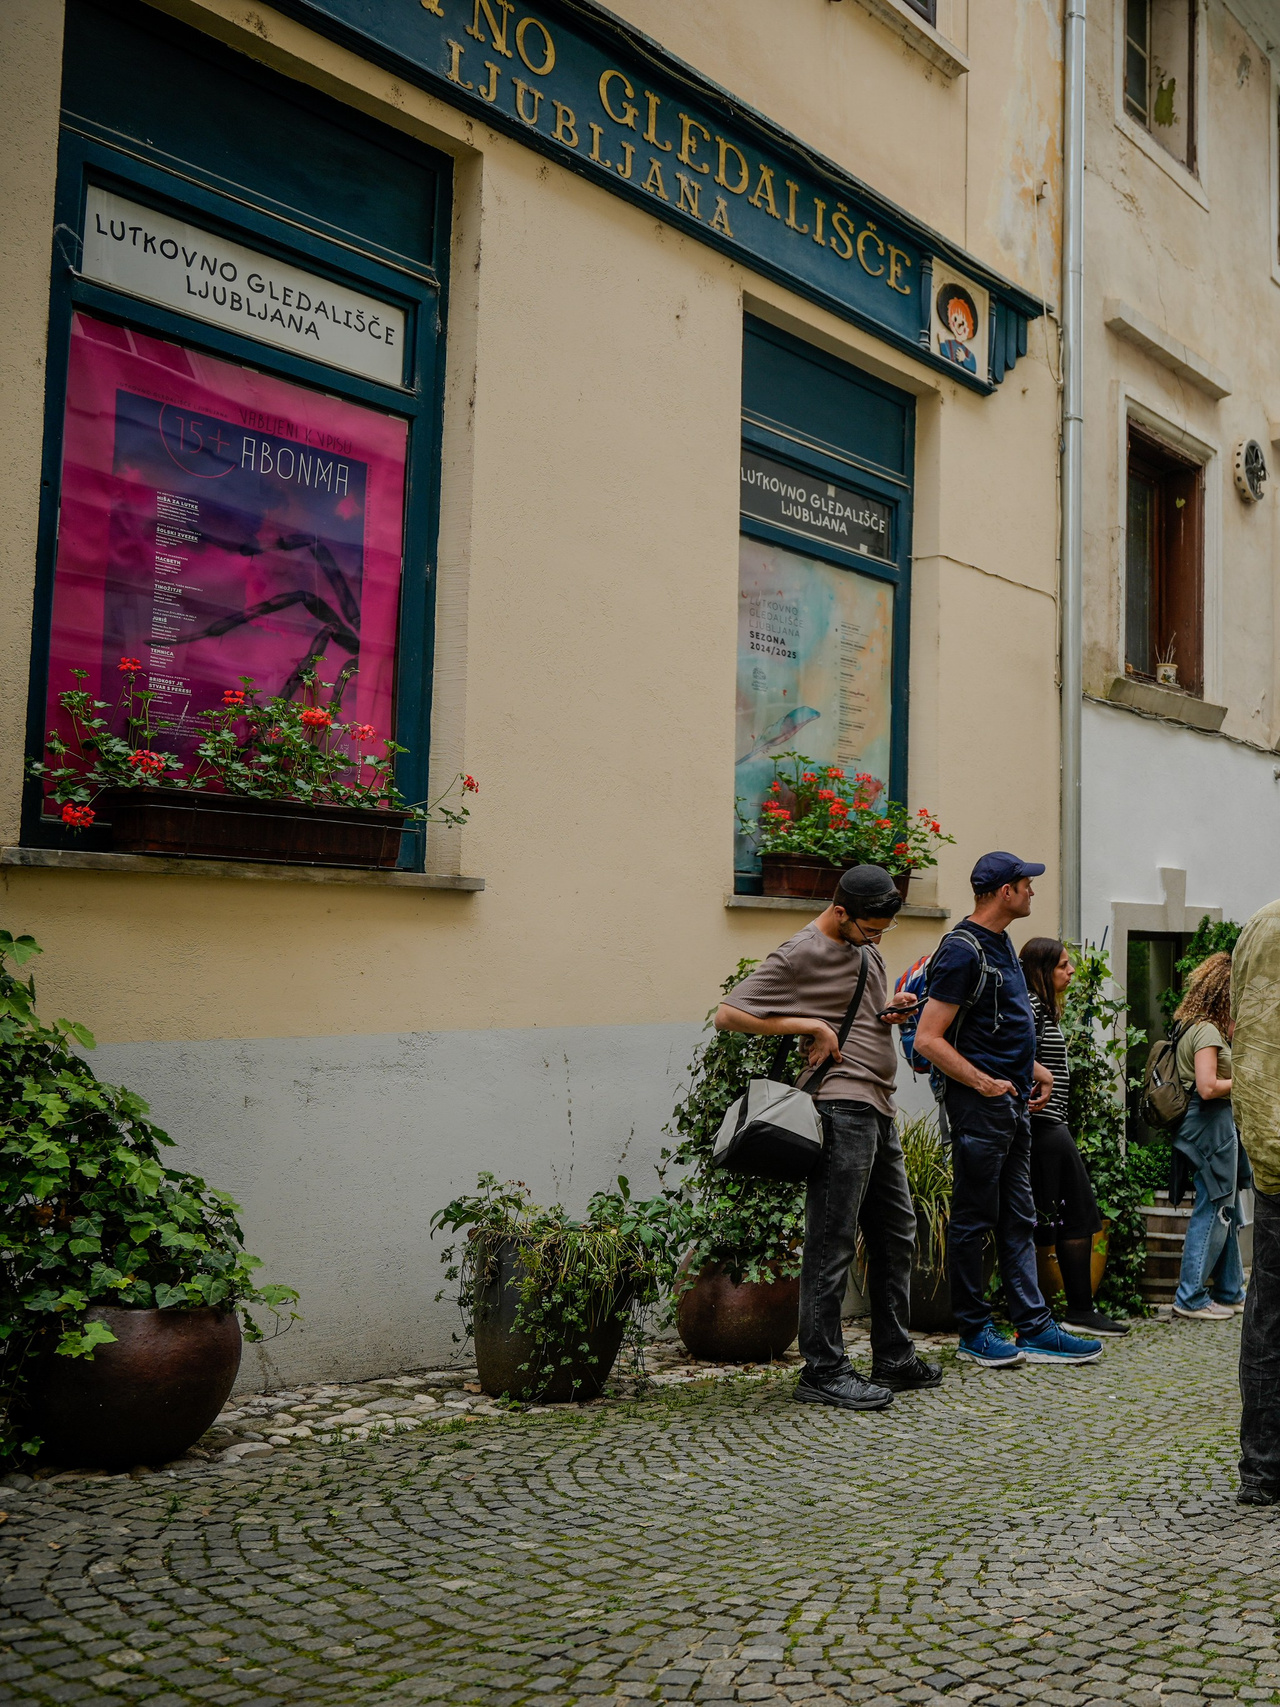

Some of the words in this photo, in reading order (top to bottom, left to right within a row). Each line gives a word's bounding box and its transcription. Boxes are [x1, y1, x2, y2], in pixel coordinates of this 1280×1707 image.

[421, 0, 556, 76] NO
[598, 69, 912, 295] GLEDALIŠČE
[446, 39, 734, 238] LJUBLJANA
[95, 213, 238, 282] LUTKOVNO
[247, 273, 395, 346] GLEDALIŠČE
[186, 275, 320, 340] LJUBLJANA
[175, 415, 231, 454] 15+
[240, 408, 299, 439] VABLJENI
[305, 426, 313, 443] K
[317, 432, 352, 455] VPISU
[241, 436, 349, 496] ABONMA
[741, 467, 807, 503] LUTKOVNO
[810, 494, 886, 534] GLEDALIŠČE
[781, 501, 848, 536] LJUBLJANA
[749, 607, 804, 629] GLEDALIŠČE
[750, 597, 799, 616] LUTKOVNO
[749, 620, 800, 637] LJUBLJANA
[749, 630, 786, 646] SEZONA
[750, 641, 797, 659] 2024/2025
